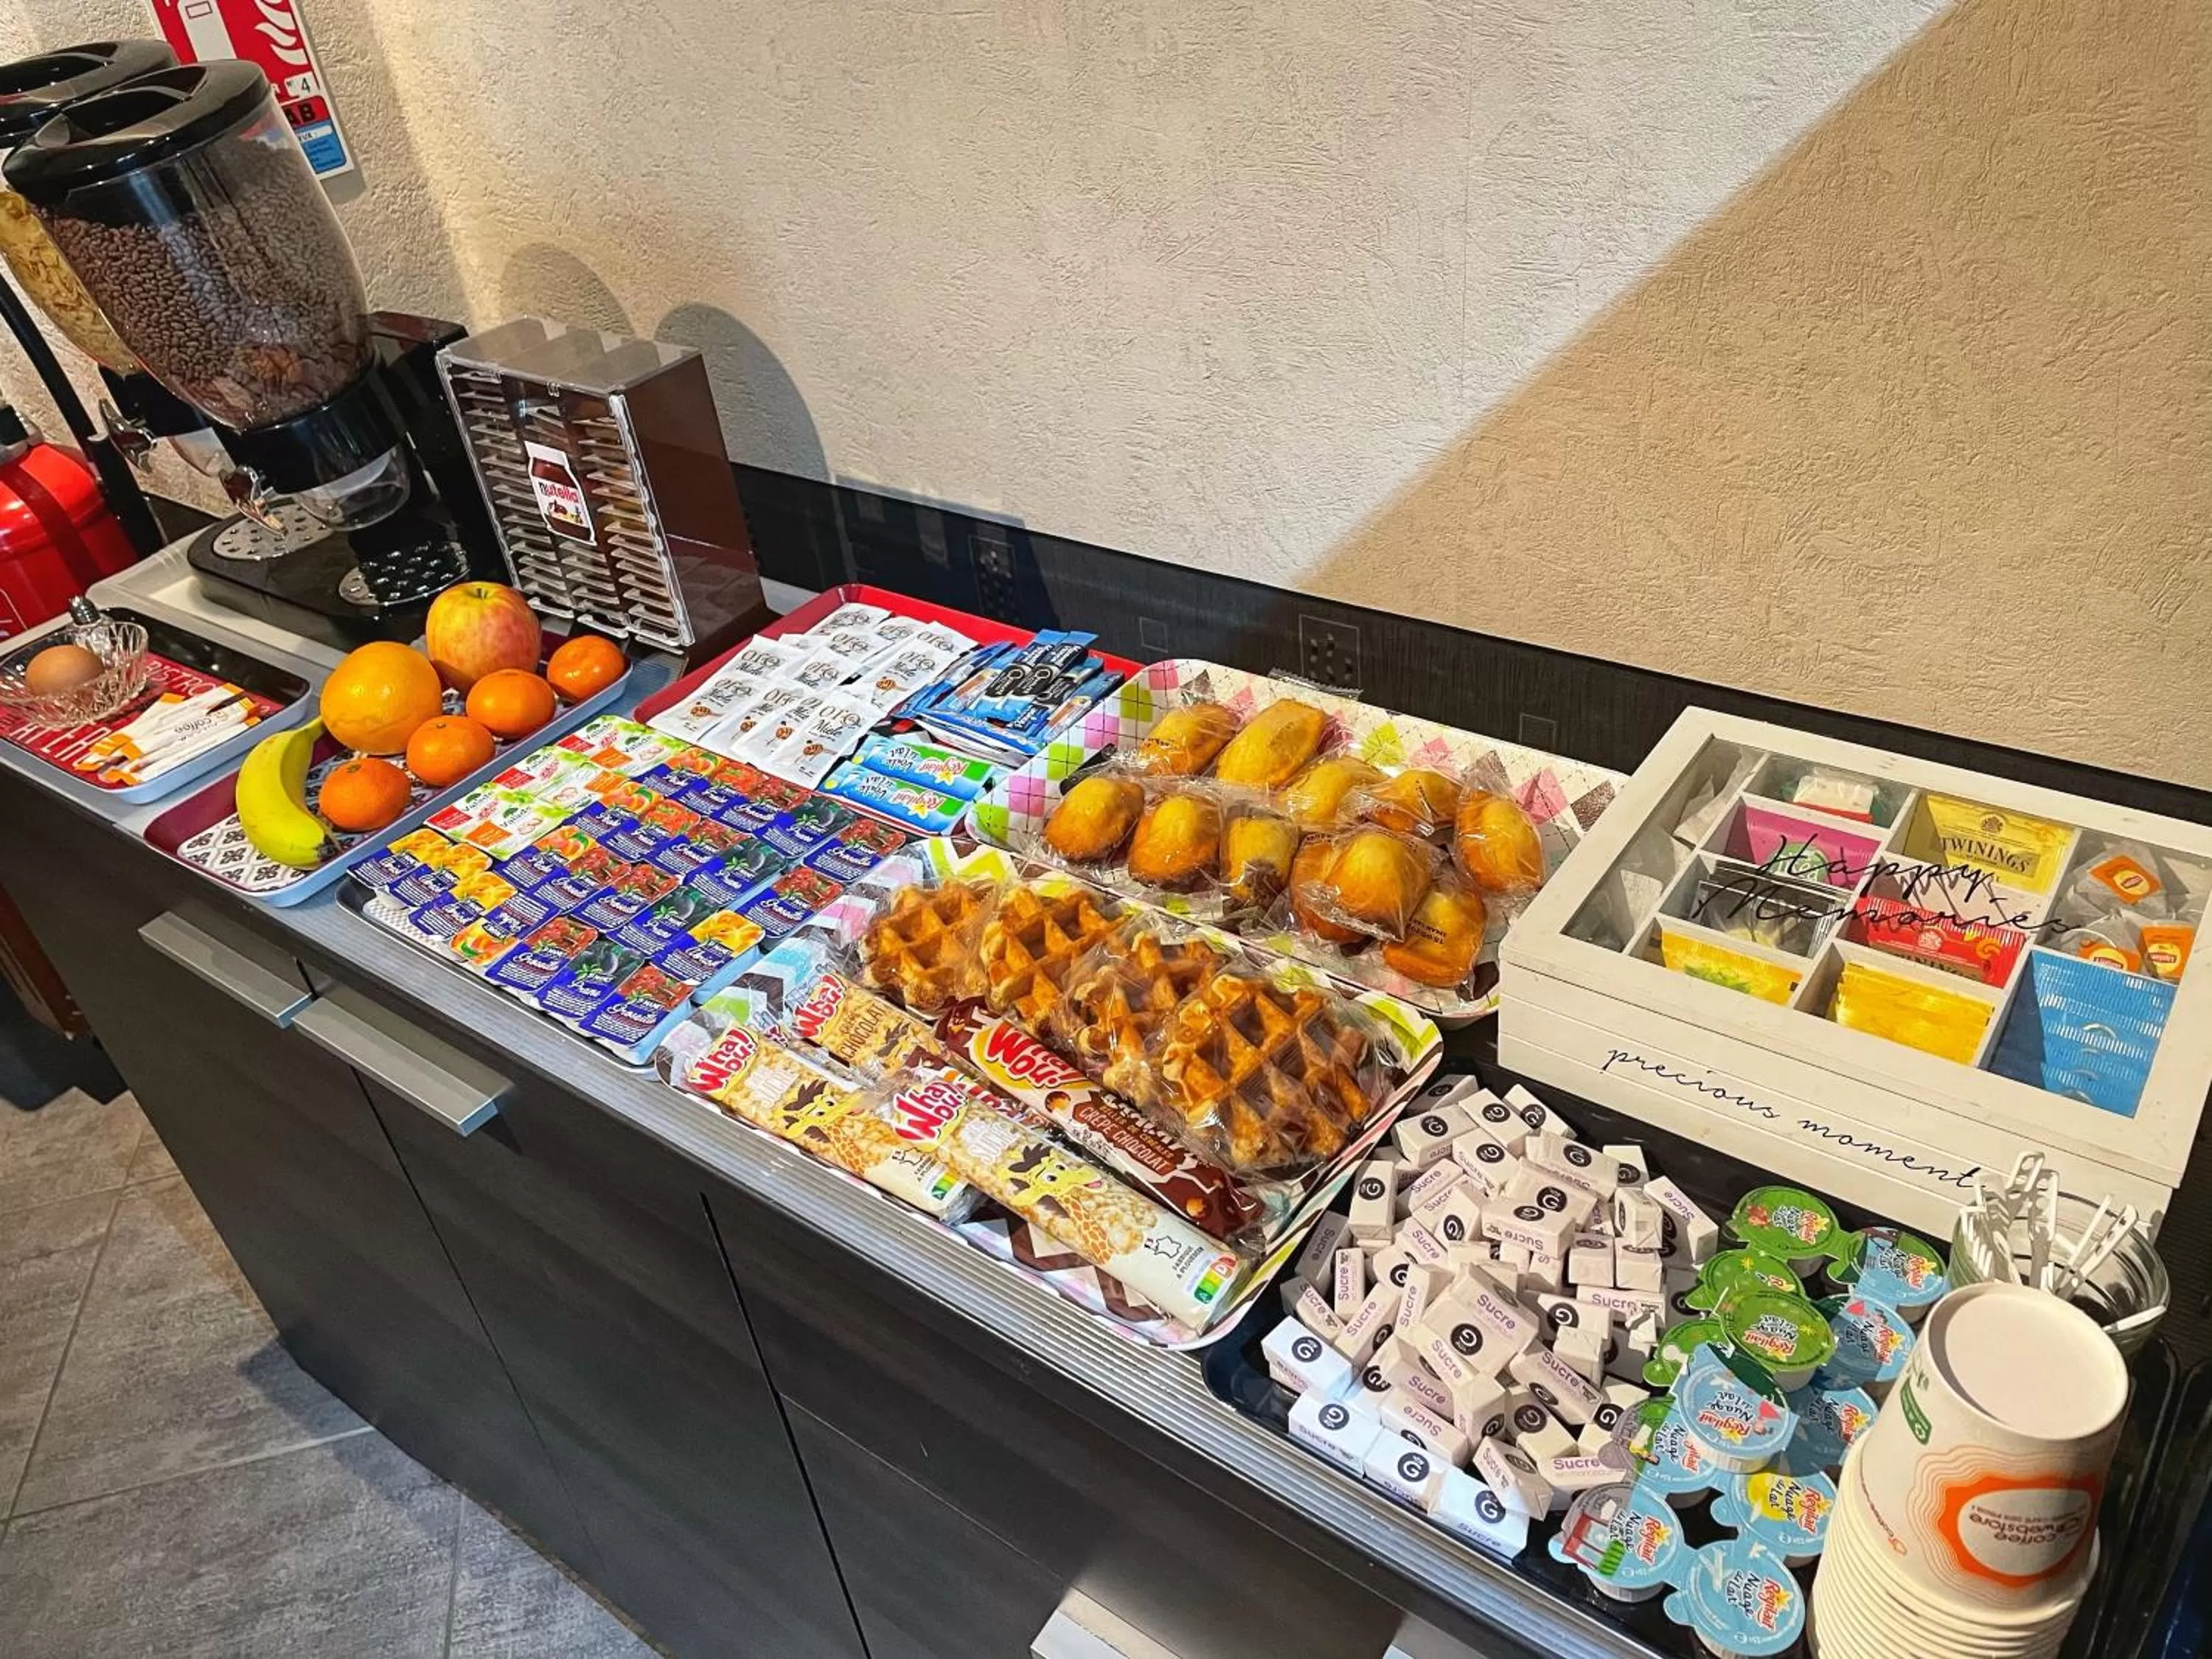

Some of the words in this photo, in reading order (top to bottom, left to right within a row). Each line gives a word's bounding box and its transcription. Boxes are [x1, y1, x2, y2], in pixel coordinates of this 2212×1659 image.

[538, 481, 580, 503] nutella
[1756, 833, 1995, 902] Happy
[1940, 836, 2030, 872] TWININGS
[1691, 877, 2084, 933] Memories
[838, 1005, 886, 1061] CHOCOLAT
[1599, 1047, 1781, 1119] precious
[1114, 1130, 1169, 1172] CHOCOLAT
[1412, 1170, 1441, 1194] Sucre
[1663, 1191, 1695, 1221] Sucre
[1312, 1229, 1335, 1261] Sucre
[1413, 1229, 1440, 1259] Sucre
[1505, 1230, 1544, 1251] Sucre
[1338, 1261, 1351, 1301] Sucre
[1300, 1284, 1326, 1315] Sucre
[1400, 1285, 1417, 1327] Sucre
[1477, 1294, 1516, 1330] Sucre
[1346, 1301, 1378, 1335] Sucre
[1432, 1339, 1463, 1380] Sucre
[1542, 1351, 1581, 1388] Sucre
[1409, 1376, 1447, 1405] Sucre
[1403, 1405, 1443, 1437] Sucre
[1709, 1400, 1754, 1422] Nuage
[1669, 1424, 1686, 1463] Nuage
[1554, 1457, 1601, 1470] Sucre
[1783, 1481, 1801, 1520] Nuage
[1623, 1511, 1642, 1550] Nuage
[1994, 1531, 2056, 1545] coffee
[1739, 1573, 1760, 1618] Nuage
